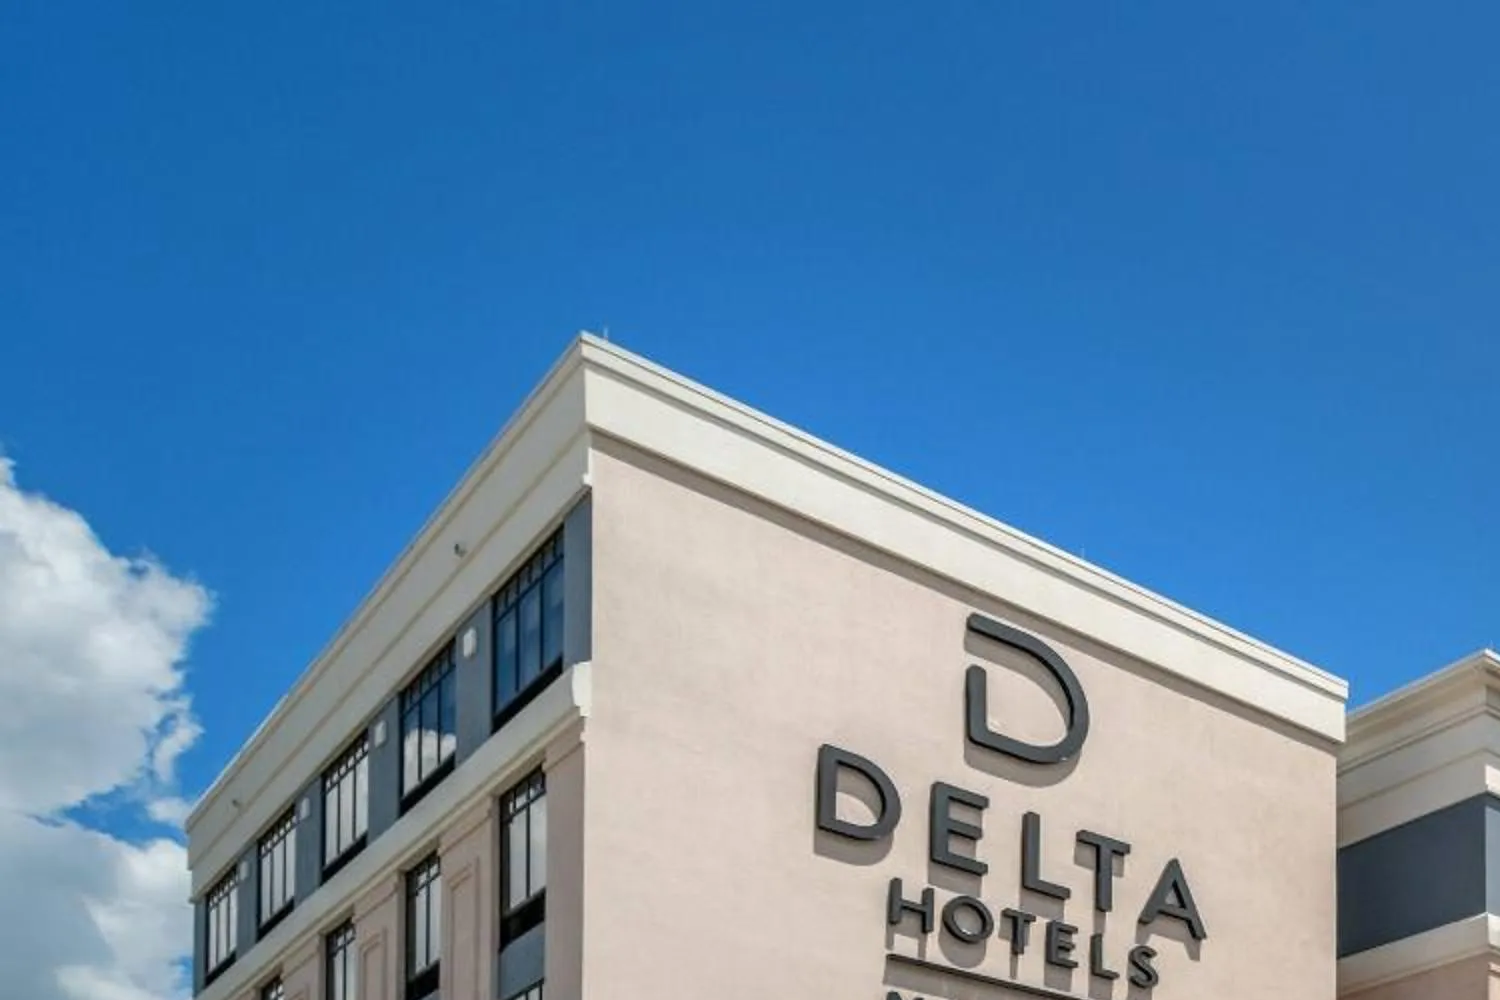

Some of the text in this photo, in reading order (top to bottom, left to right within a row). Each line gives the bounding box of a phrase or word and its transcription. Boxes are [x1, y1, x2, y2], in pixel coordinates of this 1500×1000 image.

[965, 612, 1090, 765] D
[817, 743, 1207, 941] DELTA
[887, 877, 1159, 990] HOTELS
